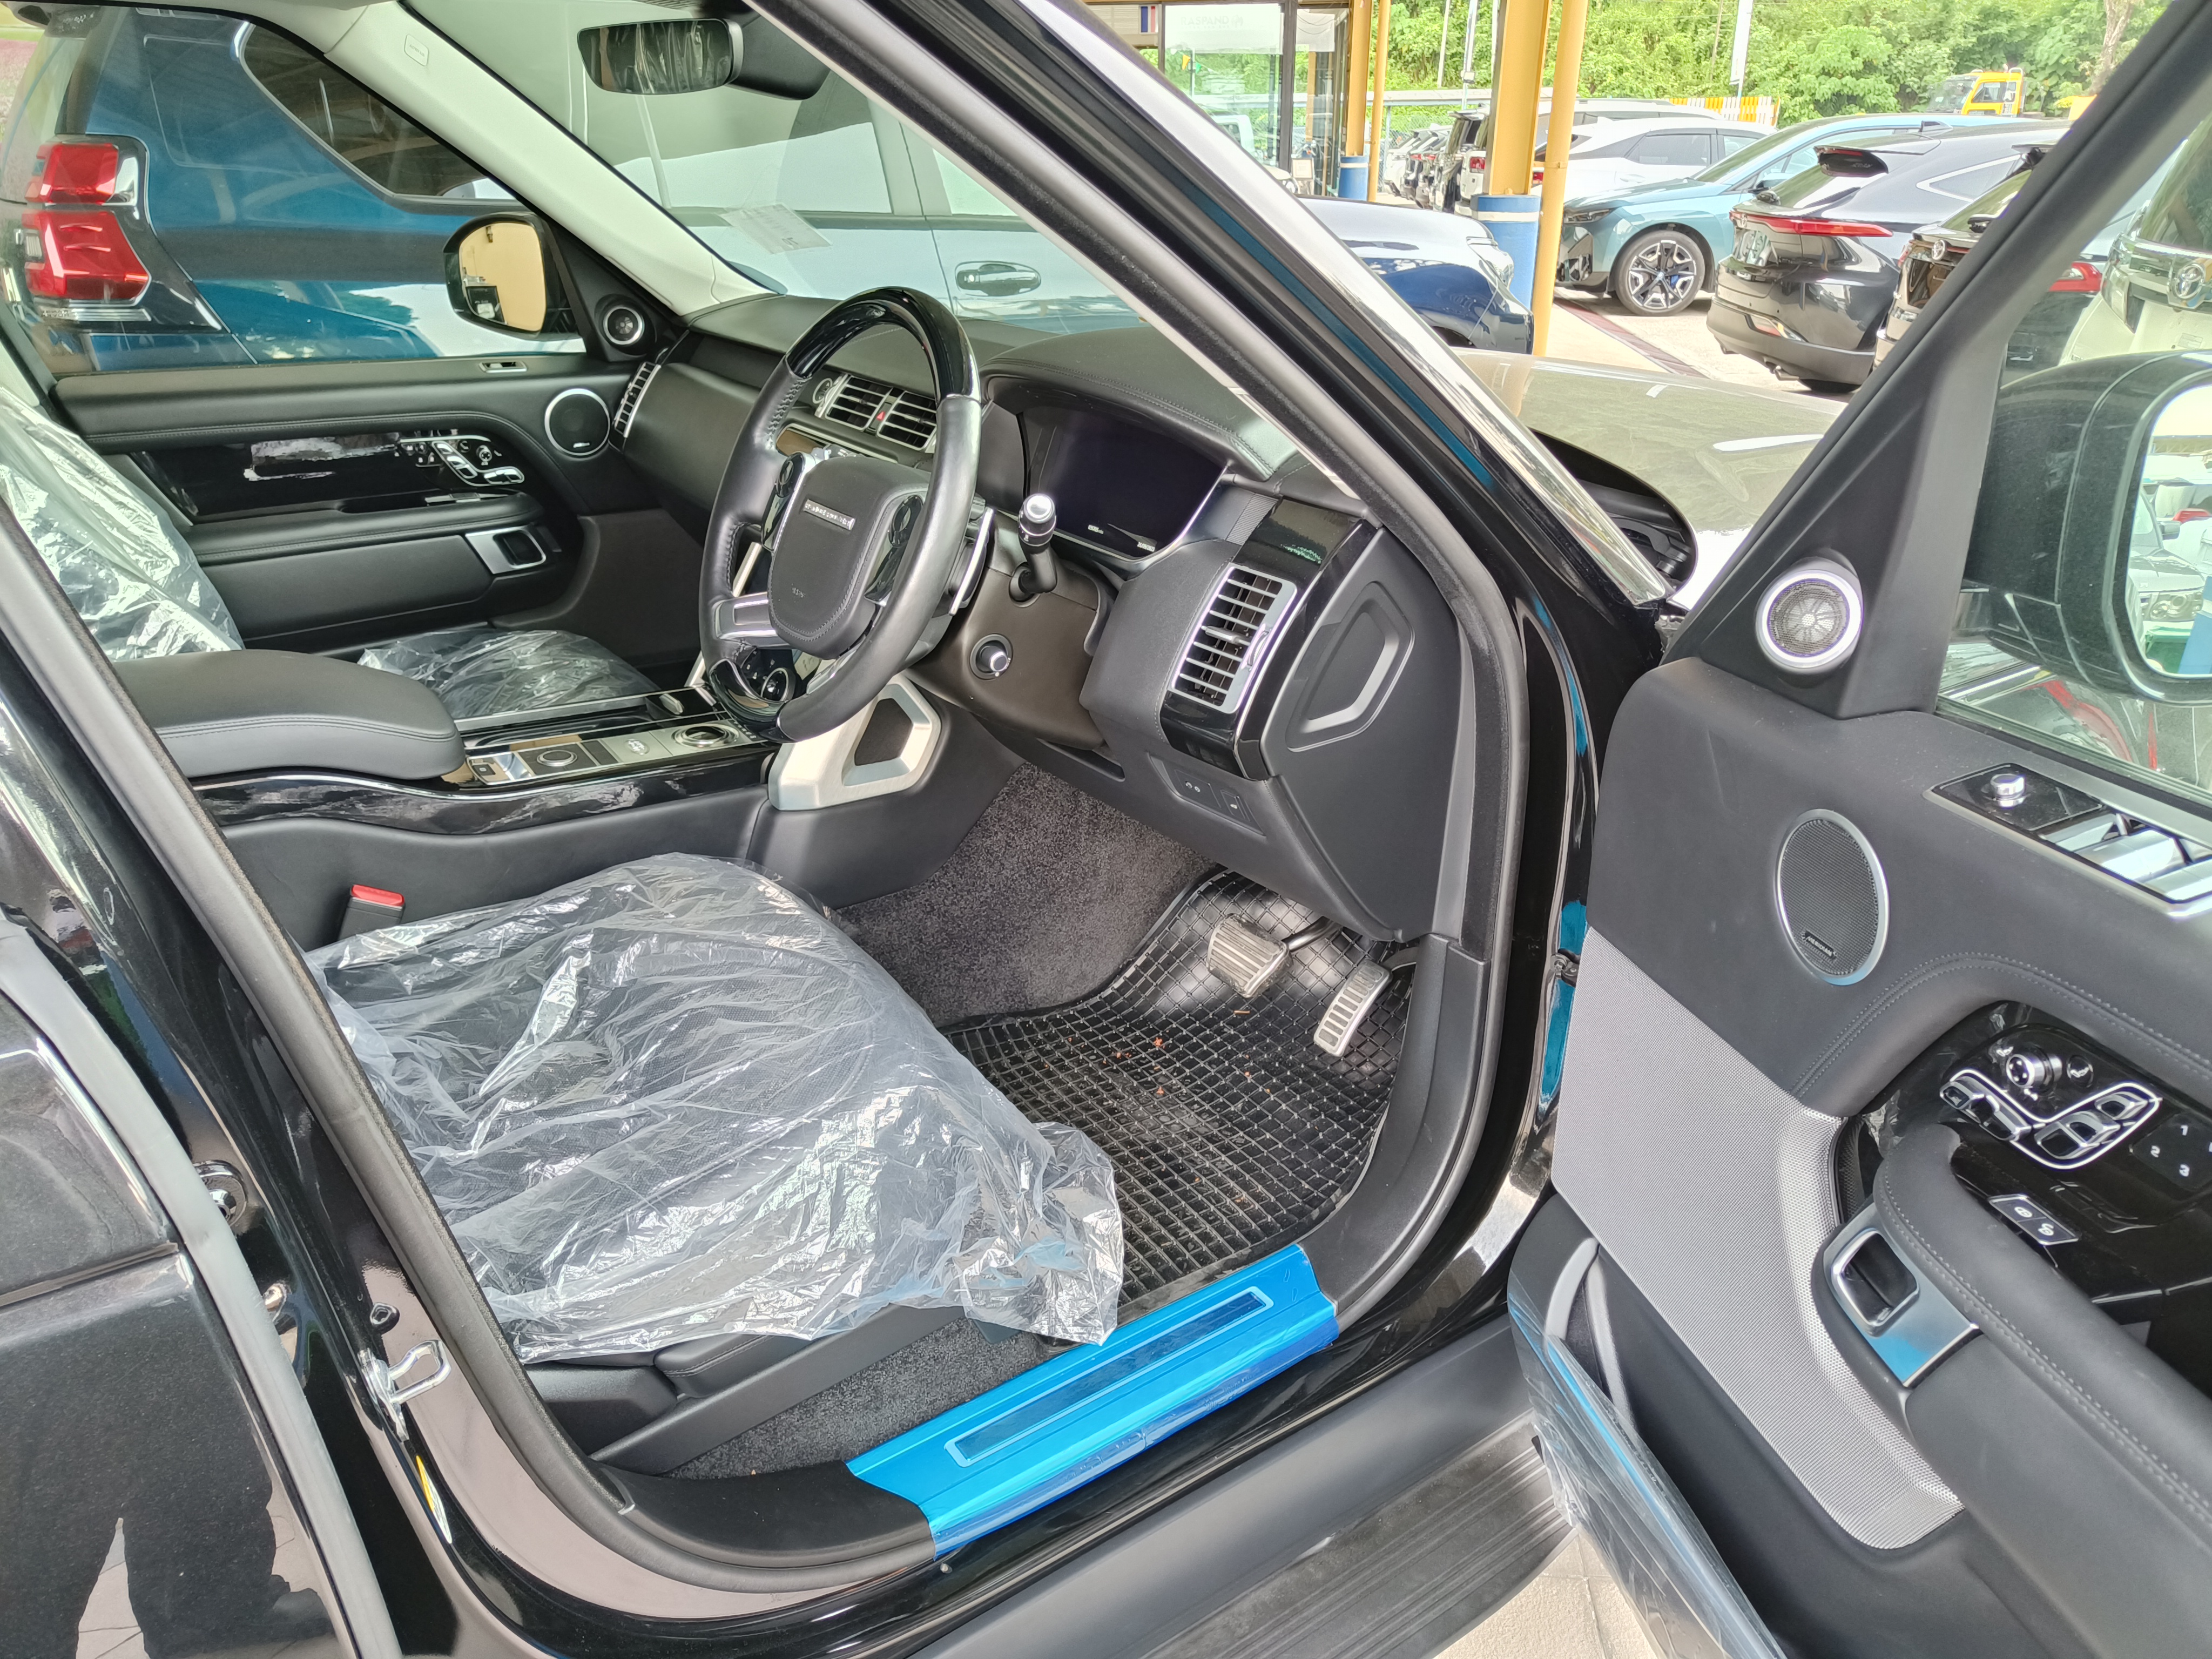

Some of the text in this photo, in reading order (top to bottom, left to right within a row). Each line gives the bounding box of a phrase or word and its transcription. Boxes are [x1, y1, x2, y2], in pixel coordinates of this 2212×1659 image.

[1181, 16, 1230, 25] RASPAND
[1806, 936, 1832, 956] MERIDIAN
[2180, 1124, 2188, 1136] 1
[2150, 1145, 2160, 1158] 2
[2179, 1163, 2190, 1177] 3
